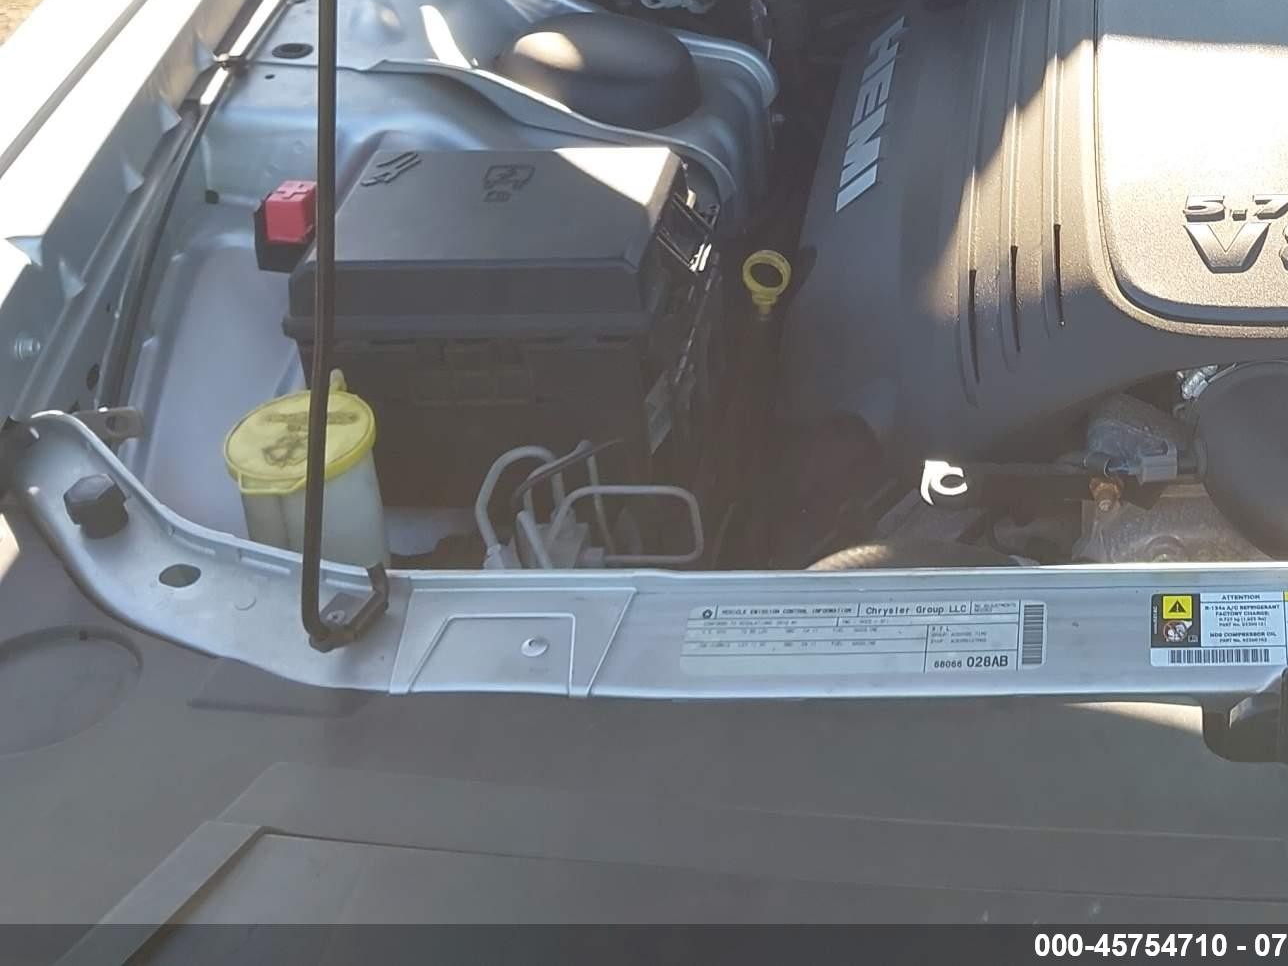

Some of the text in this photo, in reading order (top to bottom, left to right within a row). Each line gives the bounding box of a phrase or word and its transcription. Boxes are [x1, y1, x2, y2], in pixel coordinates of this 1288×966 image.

[835, 15, 904, 207] HEMI
[865, 605, 967, 617] Chrysler Group LLC
[966, 655, 1009, 668] 028AB
